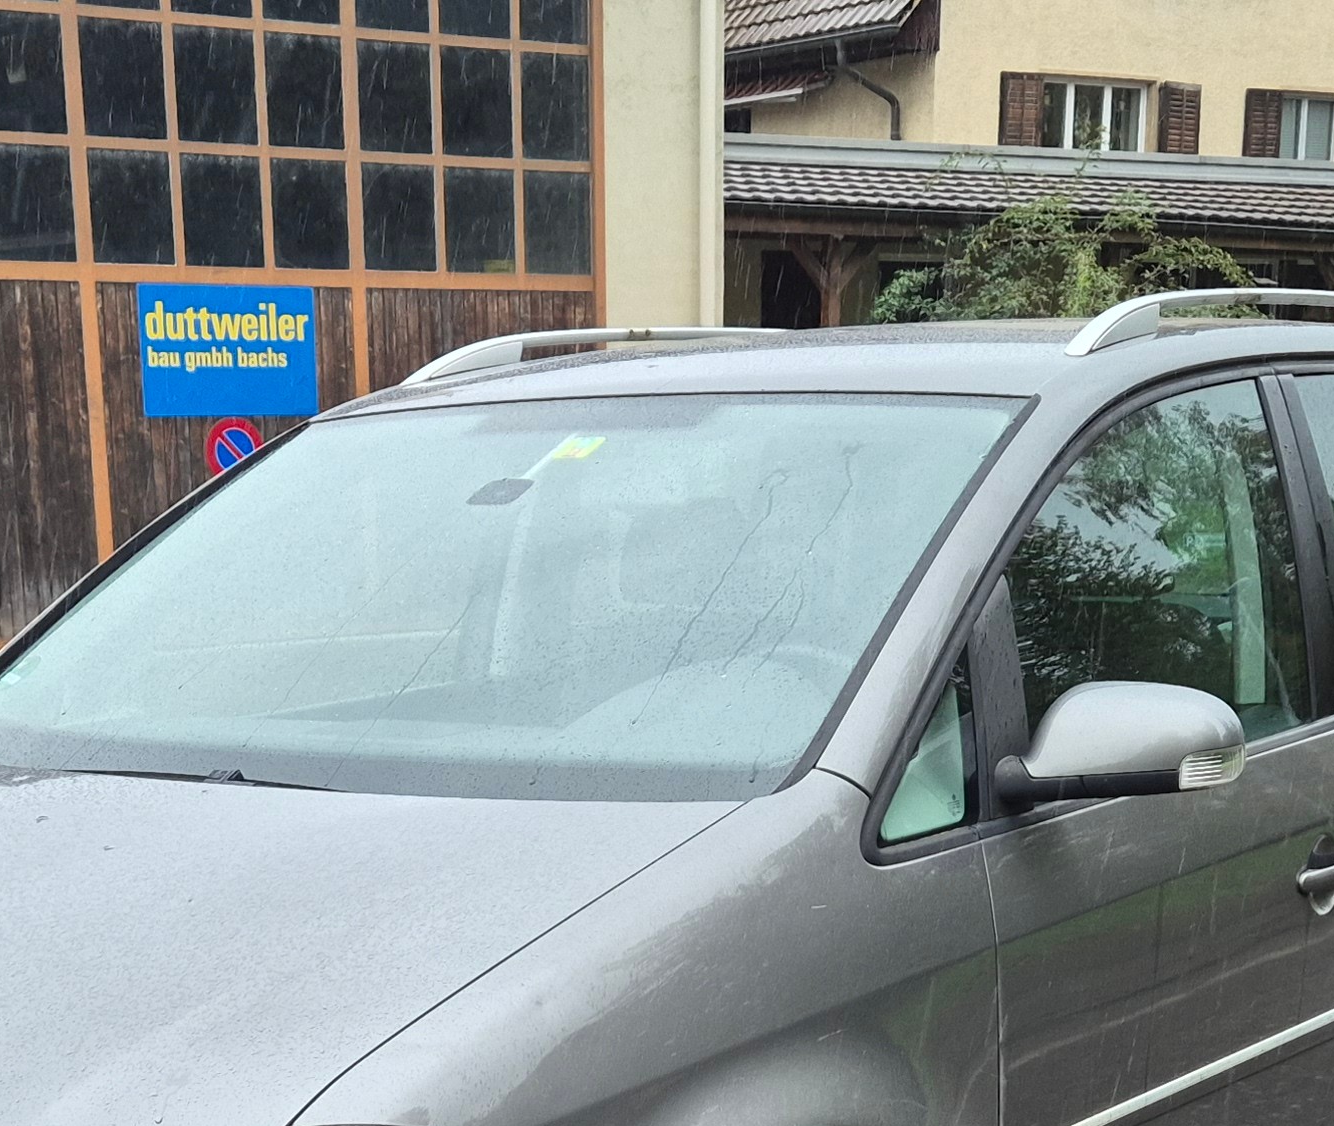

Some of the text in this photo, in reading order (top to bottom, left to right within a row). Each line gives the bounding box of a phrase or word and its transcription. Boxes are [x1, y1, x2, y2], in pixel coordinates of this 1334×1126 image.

[145, 300, 309, 341] duttweiler
[147, 346, 288, 372] bau gmbh bachs
